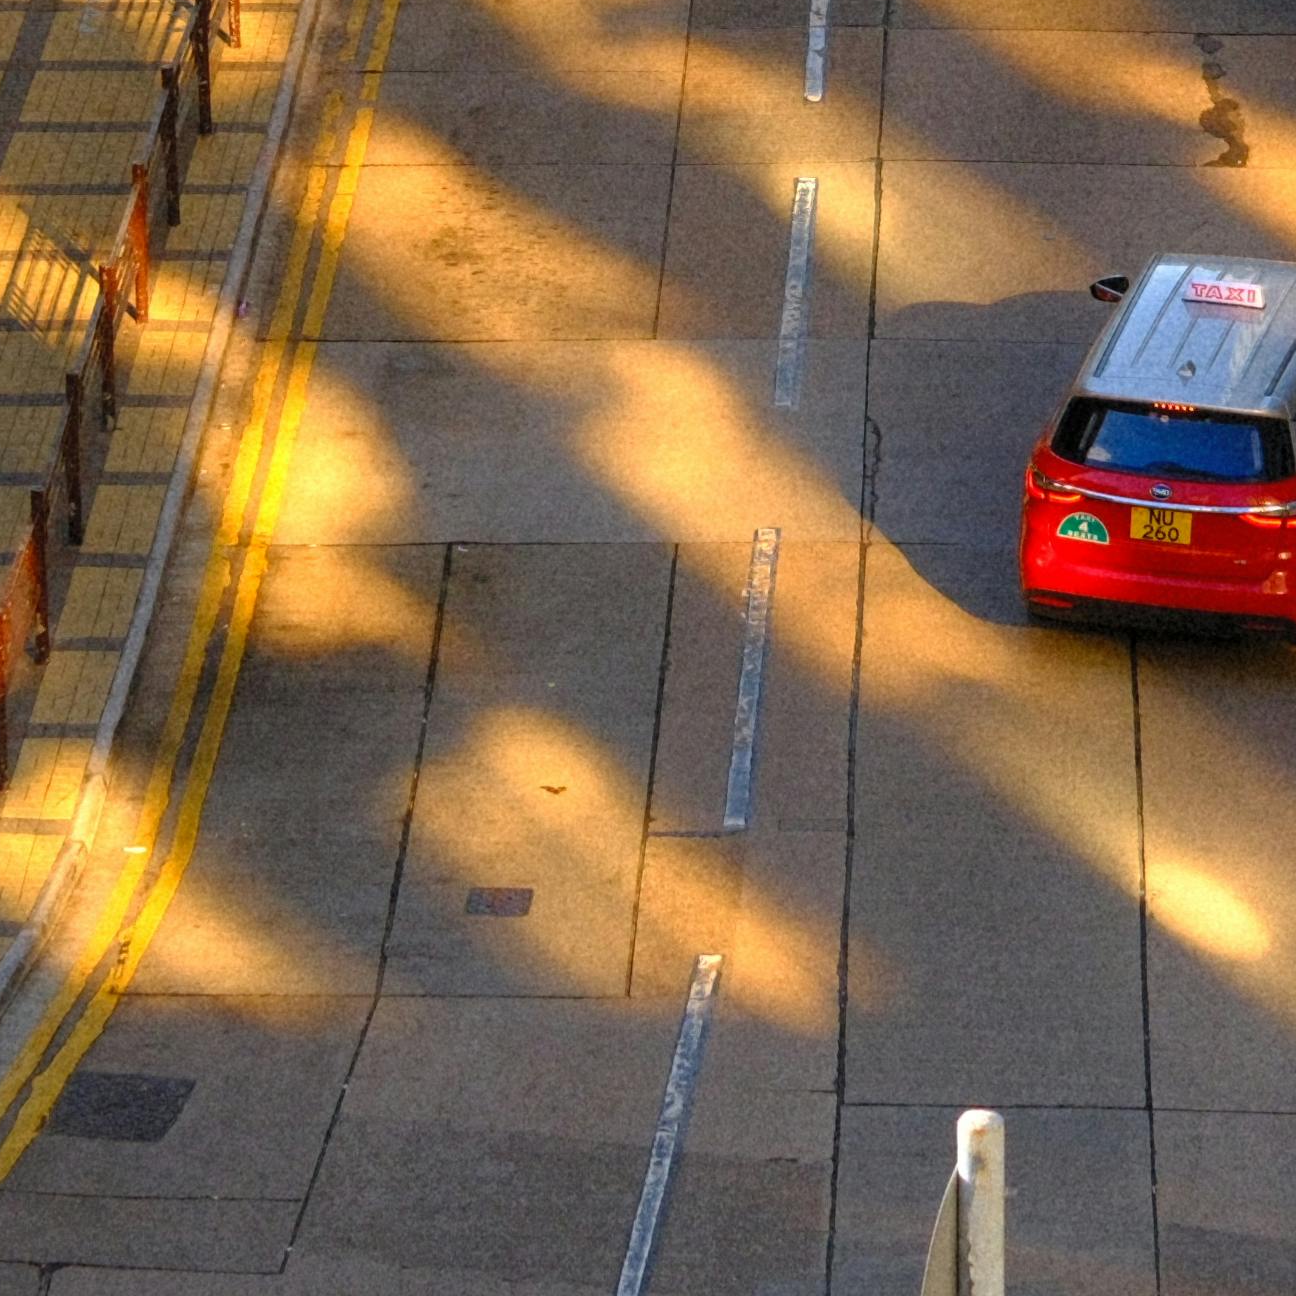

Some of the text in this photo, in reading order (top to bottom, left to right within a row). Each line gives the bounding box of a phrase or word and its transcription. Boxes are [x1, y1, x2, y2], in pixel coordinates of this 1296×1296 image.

[1191, 282, 1257, 303] TAXI
[1149, 509, 1174, 526] NU
[1078, 521, 1089, 533] 4
[1142, 524, 1180, 542] 260
